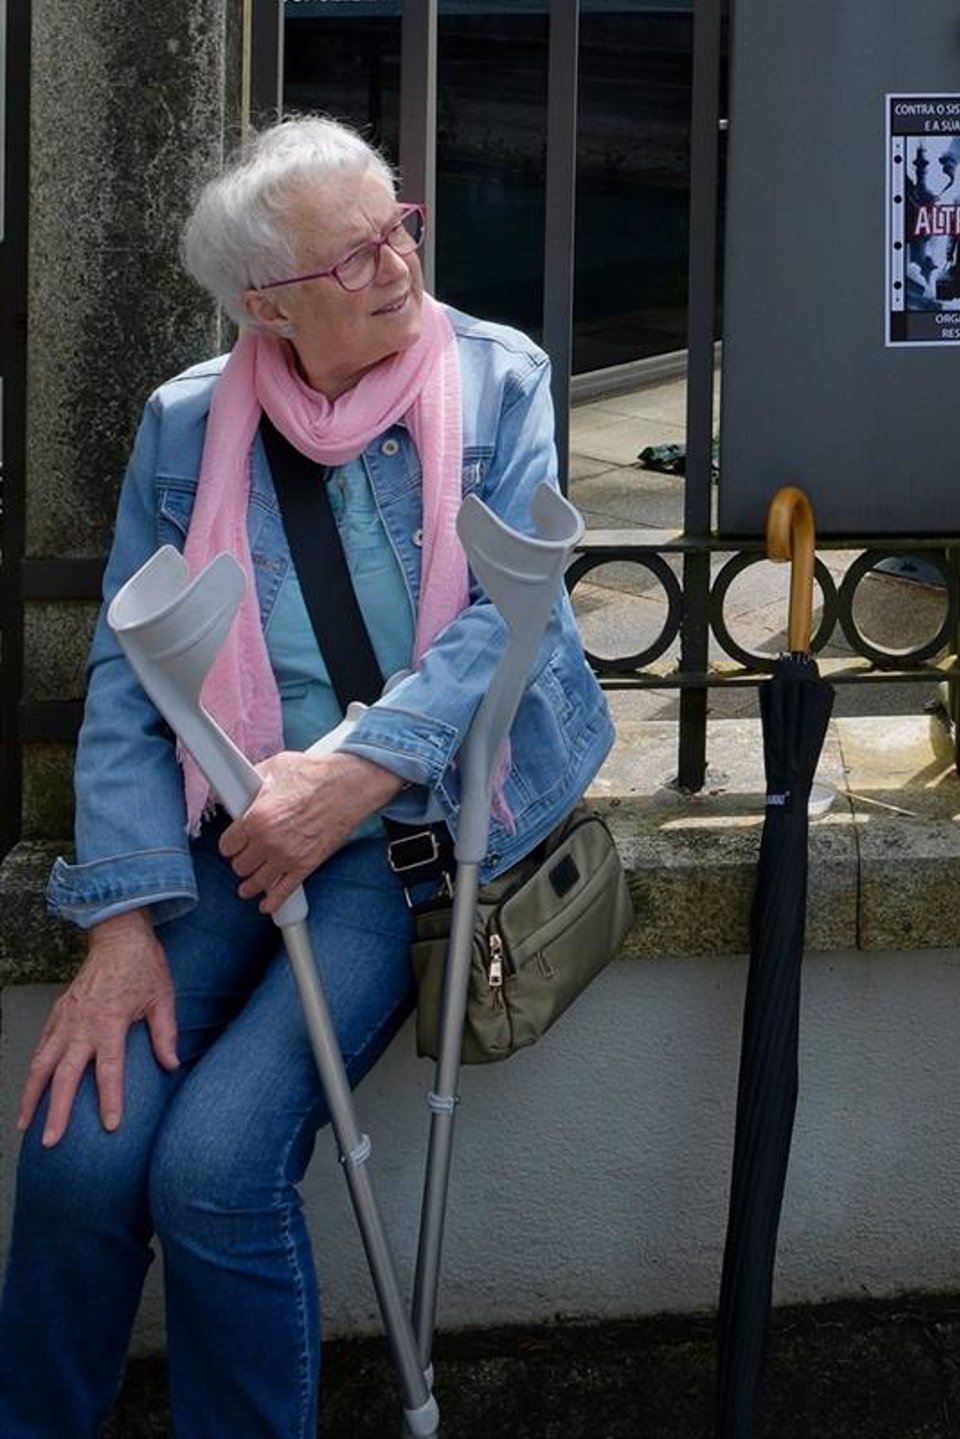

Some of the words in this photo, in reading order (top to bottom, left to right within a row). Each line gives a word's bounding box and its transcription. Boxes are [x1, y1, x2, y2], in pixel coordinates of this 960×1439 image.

[895, 103, 935, 116] CONTRA
[936, 104, 945, 115] O
[924, 120, 931, 131] E
[933, 120, 941, 131] A
